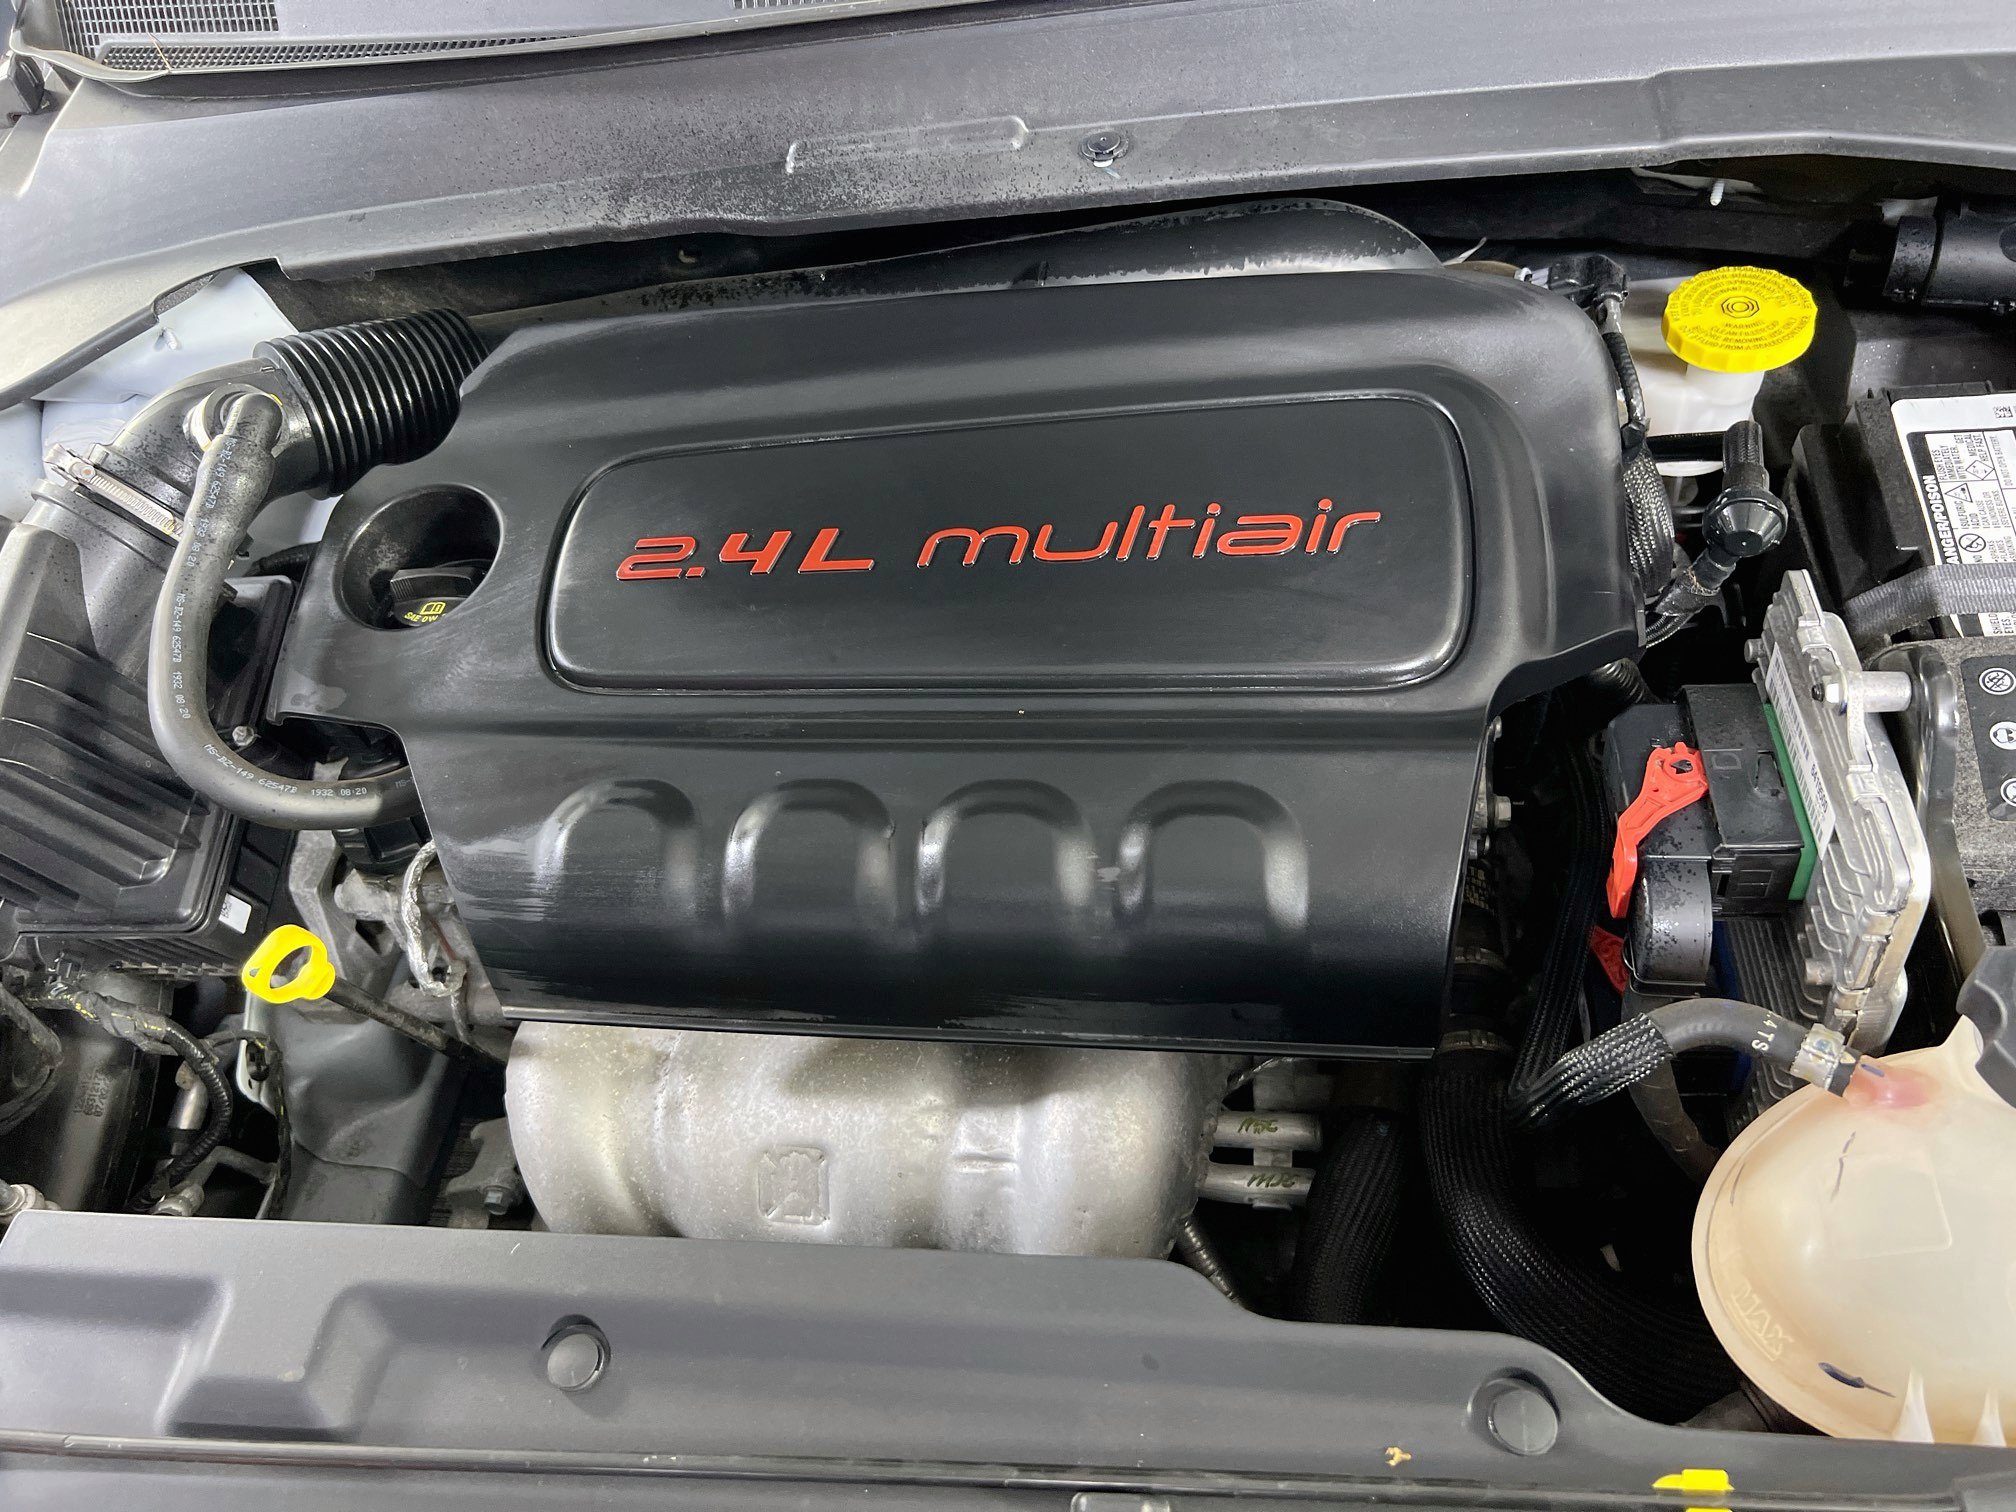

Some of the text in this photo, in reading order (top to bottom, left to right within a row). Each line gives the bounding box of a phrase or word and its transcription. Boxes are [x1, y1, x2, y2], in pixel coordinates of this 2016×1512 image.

[1954, 434, 1964, 443] GET
[1964, 434, 1977, 457] MEDICAL
[1931, 449, 1949, 480] FLUSH EYES
[1940, 445, 1957, 479] IMMEDIATELY
[1978, 449, 1988, 461] HELP
[1955, 466, 1967, 479] WITH
[1923, 474, 1959, 565] ANGER/POISON
[1954, 500, 1970, 526] SULFURIC
[1969, 513, 1980, 526] ACID
[1976, 500, 1990, 526] CAN CAUSE
[1997, 507, 2010, 526] SEVERE
[916, 498, 1382, 567] multiair
[404, 611, 447, 623] SAE 0W-
[1988, 613, 2003, 634] SHIELD
[172, 671, 183, 689] 1932
[311, 788, 334, 797] 1932
[340, 787, 368, 797] 08:20
[1730, 1275, 1795, 1357] MAX
